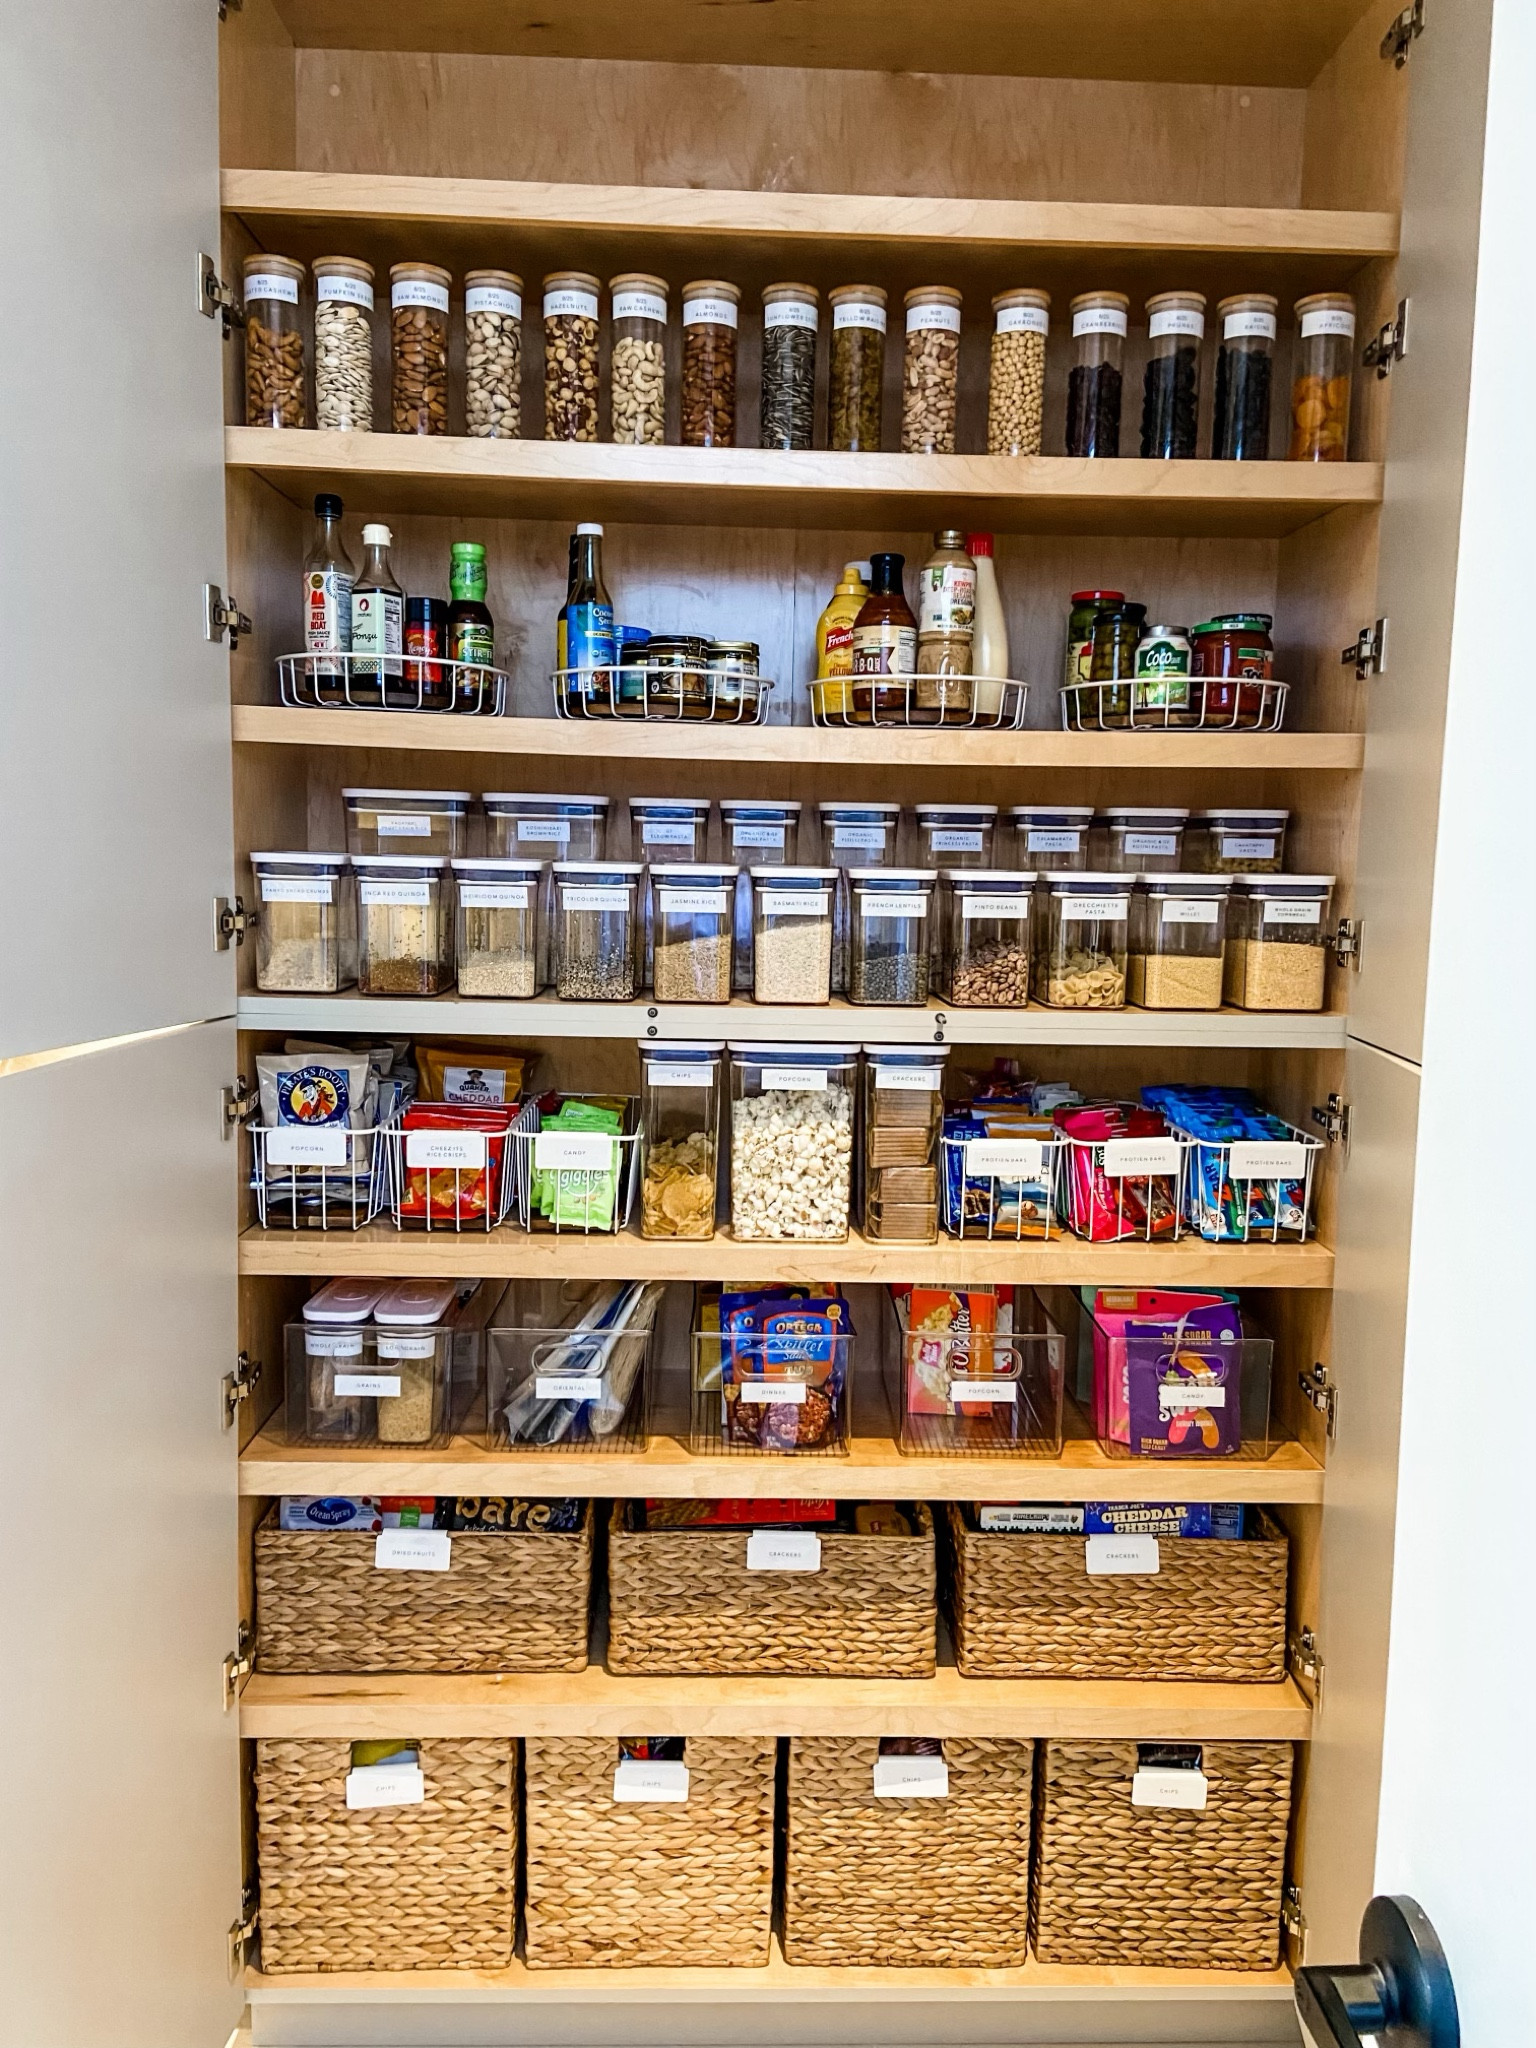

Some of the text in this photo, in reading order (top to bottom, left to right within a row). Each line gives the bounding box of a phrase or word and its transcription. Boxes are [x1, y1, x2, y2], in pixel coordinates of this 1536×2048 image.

[264, 288, 295, 297] CASHEWS
[411, 294, 444, 304] ALMONDS
[474, 300, 514, 310] PISTACHIOS
[312, 612, 325, 621] RED
[310, 622, 326, 630] BOAT
[352, 632, 378, 643] Ponzu
[281, 1068, 347, 1096] PIRATE'S BOOTY
[449, 1094, 500, 1104] CHEDDAR
[776, 1322, 823, 1334] ORTEGA
[774, 1338, 824, 1353] Skillet
[310, 1506, 331, 1520] Ocean
[331, 1508, 351, 1521] Spray
[455, 1496, 550, 1532] bare
[1102, 1506, 1189, 1524] CHEDDAR
[1114, 1520, 1181, 1534] CHEESE
